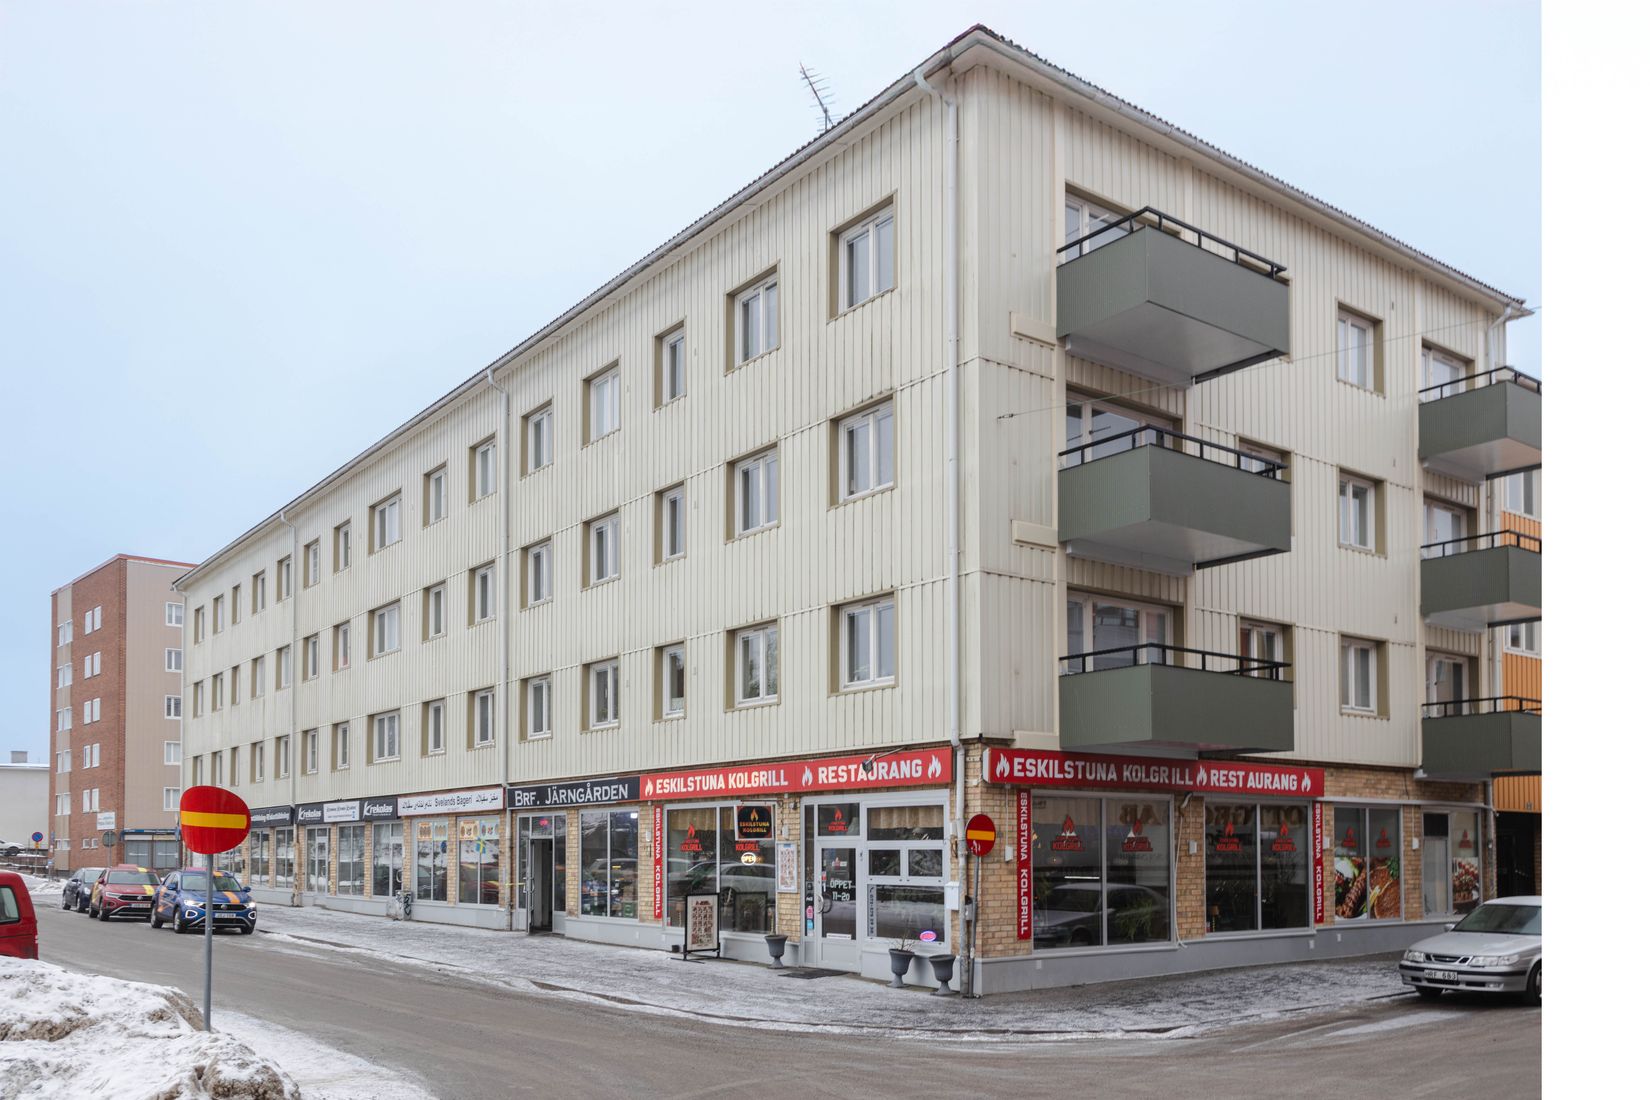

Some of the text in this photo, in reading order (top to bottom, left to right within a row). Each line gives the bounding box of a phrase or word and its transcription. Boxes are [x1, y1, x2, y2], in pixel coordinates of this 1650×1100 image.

[656, 769, 789, 794] ESKILSTUNA KOLGRILL
[818, 759, 923, 784] RESTAURANG
[1013, 757, 1193, 786] ESKILSTUNA KOLGRILL
[456, 795, 473, 807] Bageri
[1020, 792, 1029, 934] ESKILSTUNA KOLGRILL
